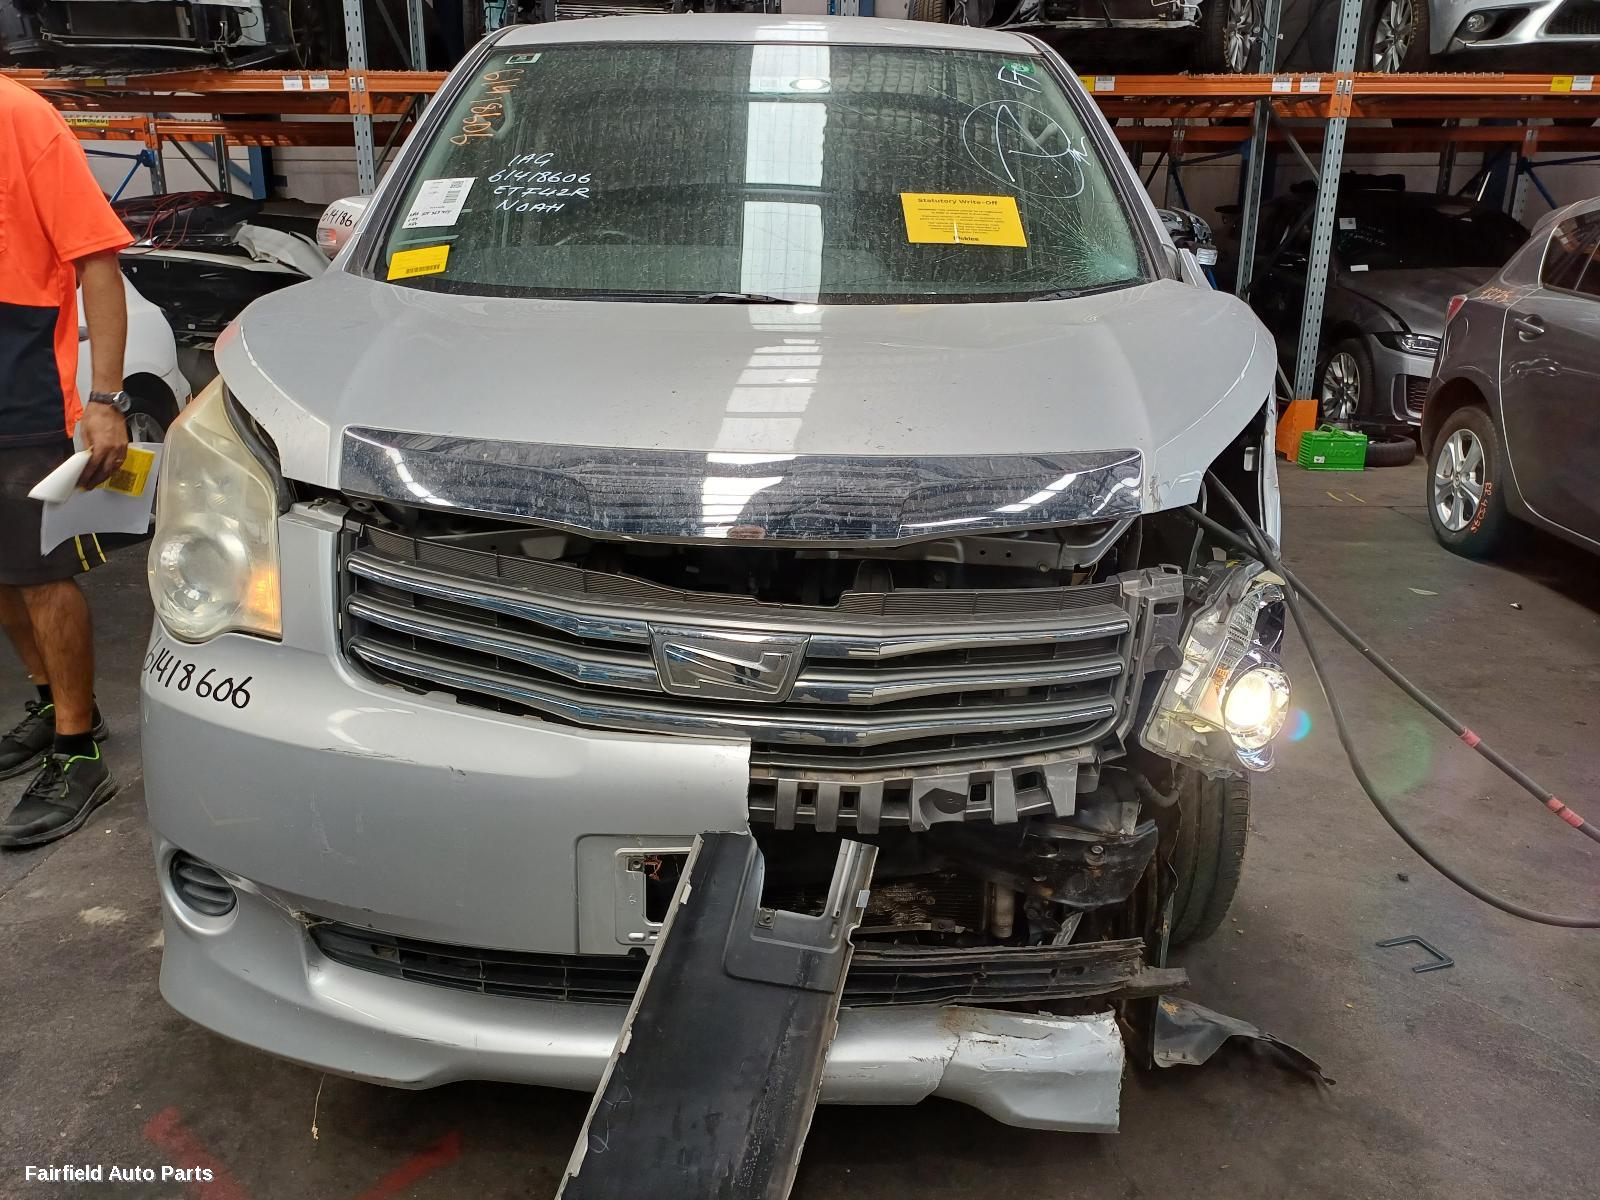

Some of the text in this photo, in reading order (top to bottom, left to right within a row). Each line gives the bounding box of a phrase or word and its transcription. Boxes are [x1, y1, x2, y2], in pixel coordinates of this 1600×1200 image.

[487, 168, 592, 184] 61418606
[495, 198, 565, 213] NOAH
[917, 197, 998, 206] Statutory Write-Off
[143, 636, 253, 709] 61418606
